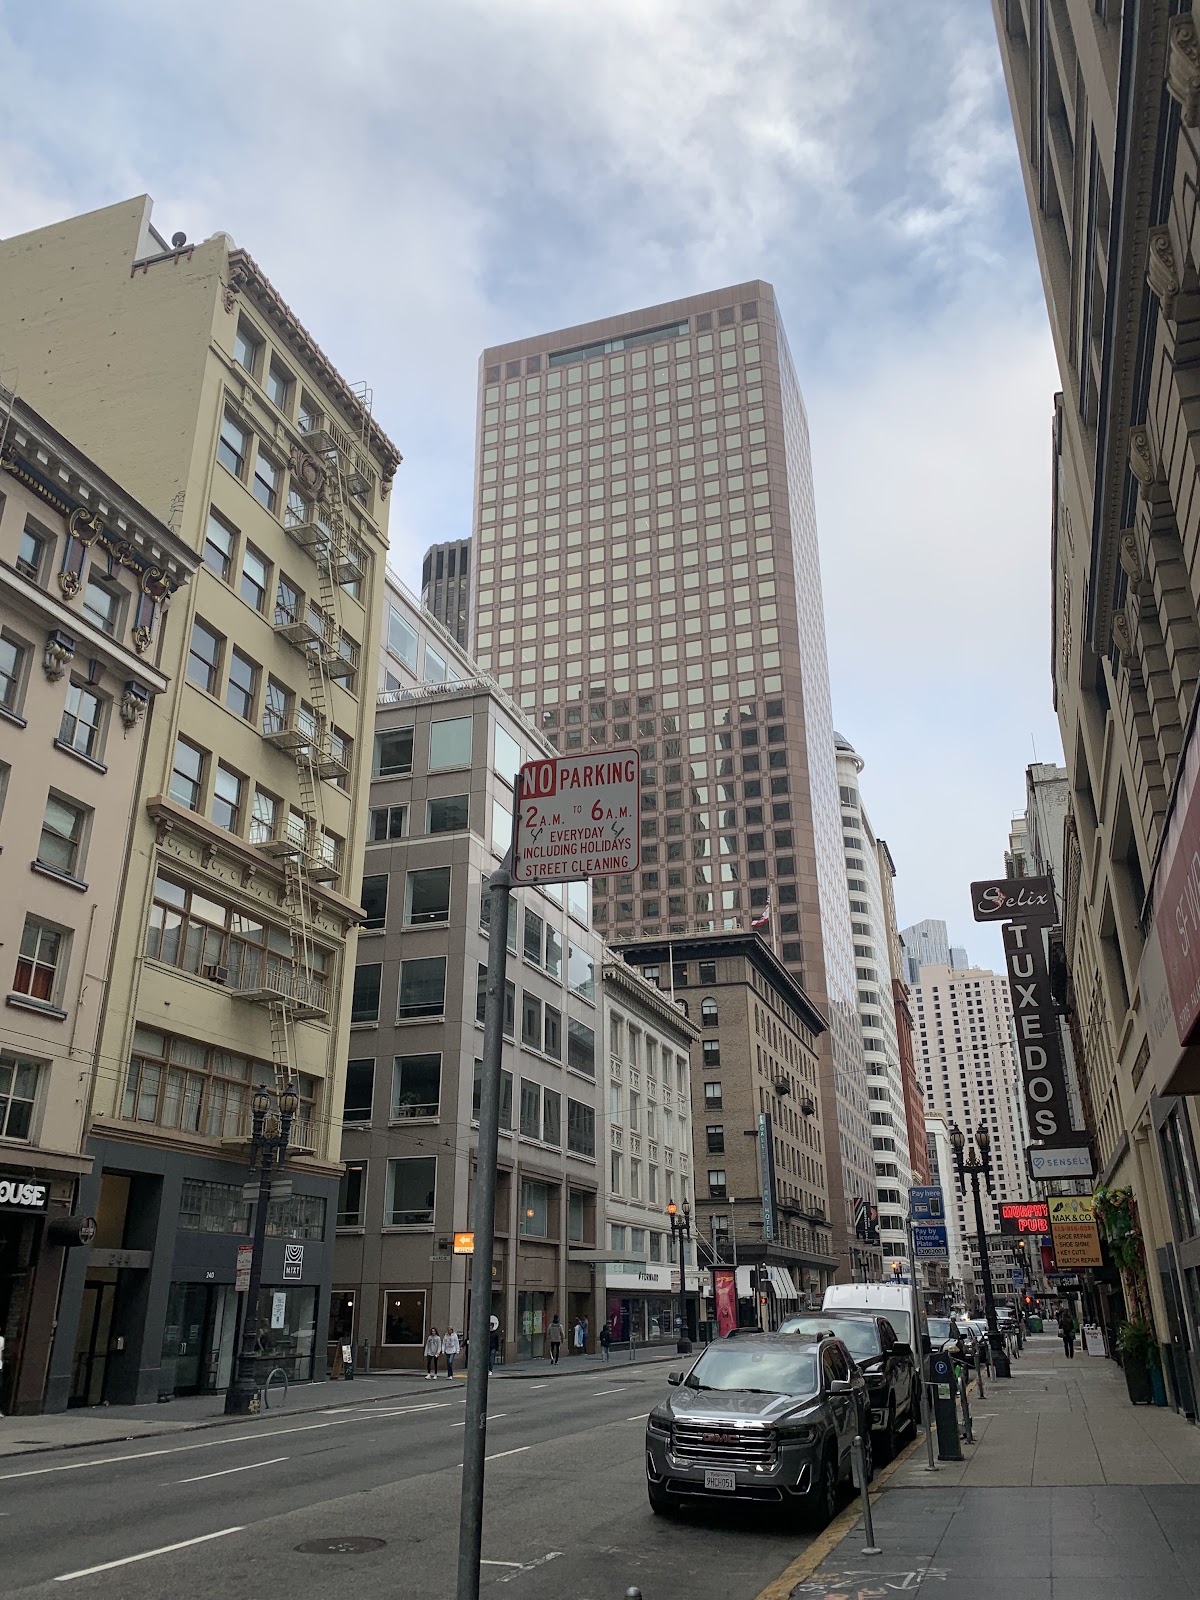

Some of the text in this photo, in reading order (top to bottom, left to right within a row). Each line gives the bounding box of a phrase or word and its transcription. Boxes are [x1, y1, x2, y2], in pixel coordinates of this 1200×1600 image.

[523, 760, 635, 796] NO PARKING
[573, 805, 582, 814] TO
[550, 826, 605, 843] EVERYDAY
[523, 838, 632, 860] INCLUDING HOLIDAYS
[525, 855, 629, 877] STREET CLEANING
[977, 886, 1049, 913] Selix
[1008, 924, 1058, 1136] TUXEDOS
[1047, 1157, 1090, 1167] SENSELY
[911, 1189, 940, 1198] Pay here
[1052, 1214, 1071, 1222] MAK
[1079, 1213, 1094, 1221] CO.
[927, 1227, 937, 1235] by
[1018, 1218, 1048, 1232] PUB
[285, 1266, 300, 1275] MIXT
